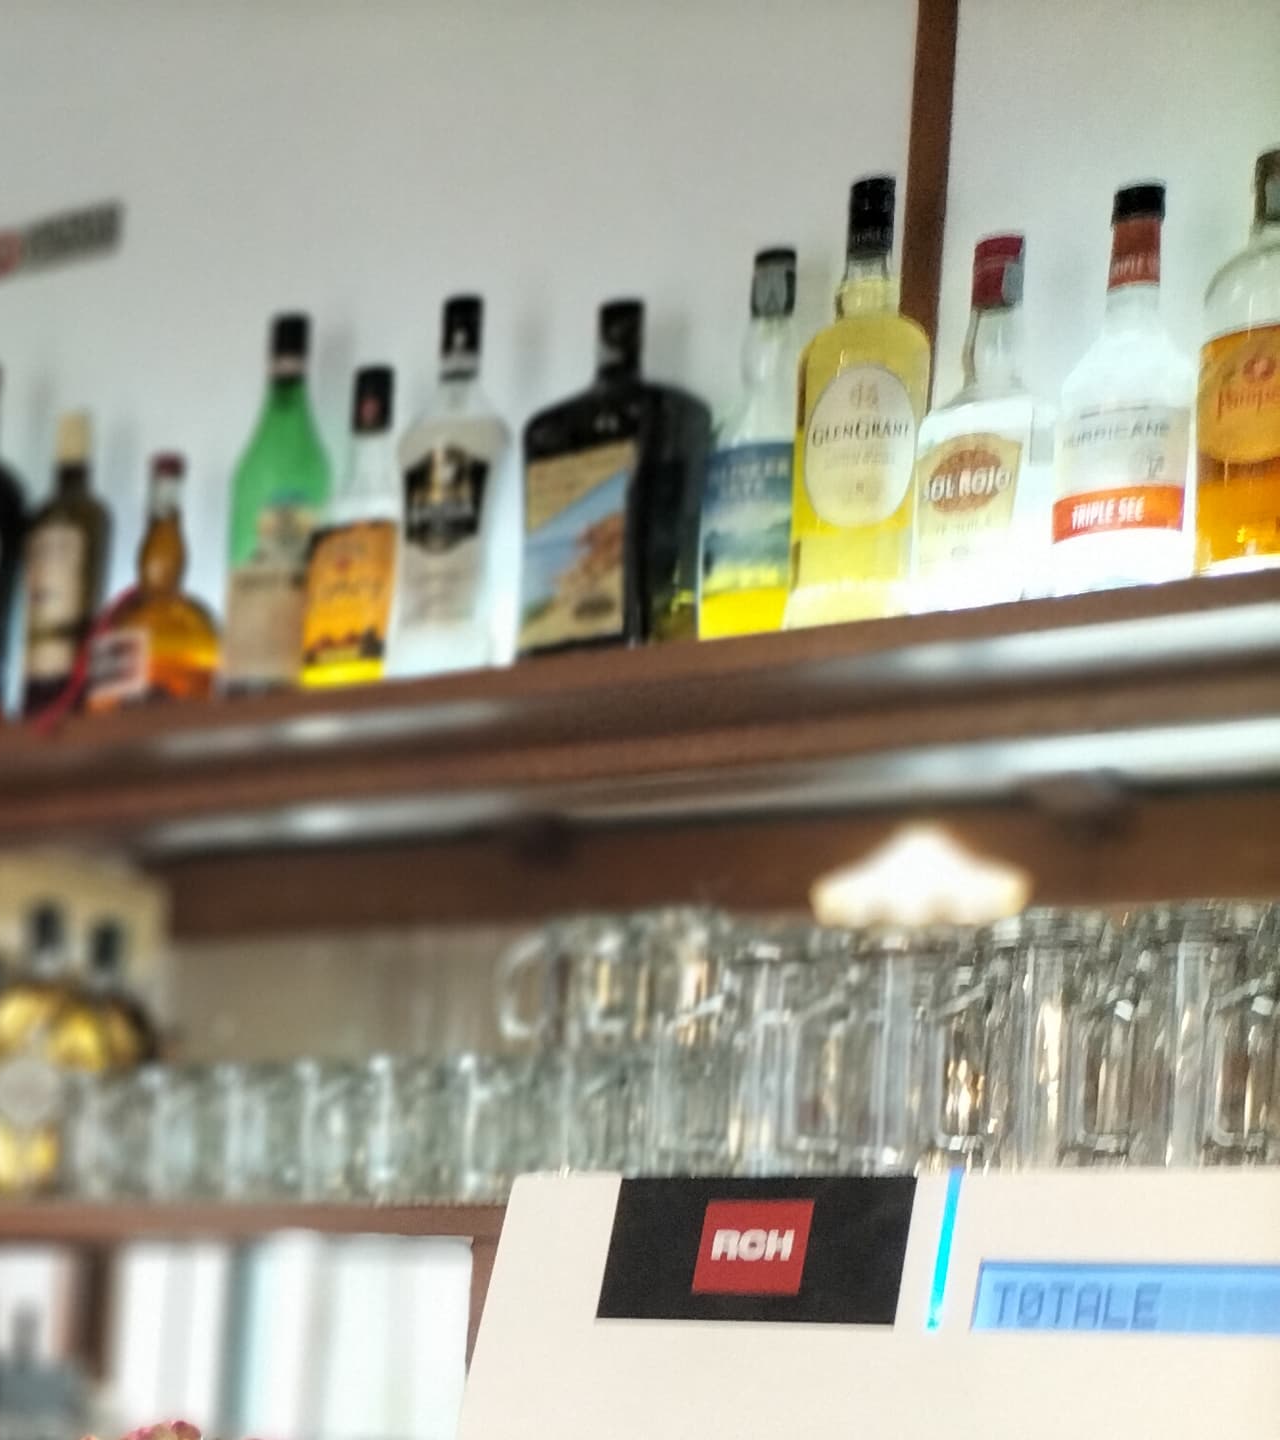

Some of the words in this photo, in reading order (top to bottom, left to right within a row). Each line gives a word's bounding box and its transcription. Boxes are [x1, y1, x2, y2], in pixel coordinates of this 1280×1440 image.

[1071, 497, 1115, 531] TRIPLE
[1118, 495, 1146, 523] SEC
[711, 1228, 795, 1262] RCH
